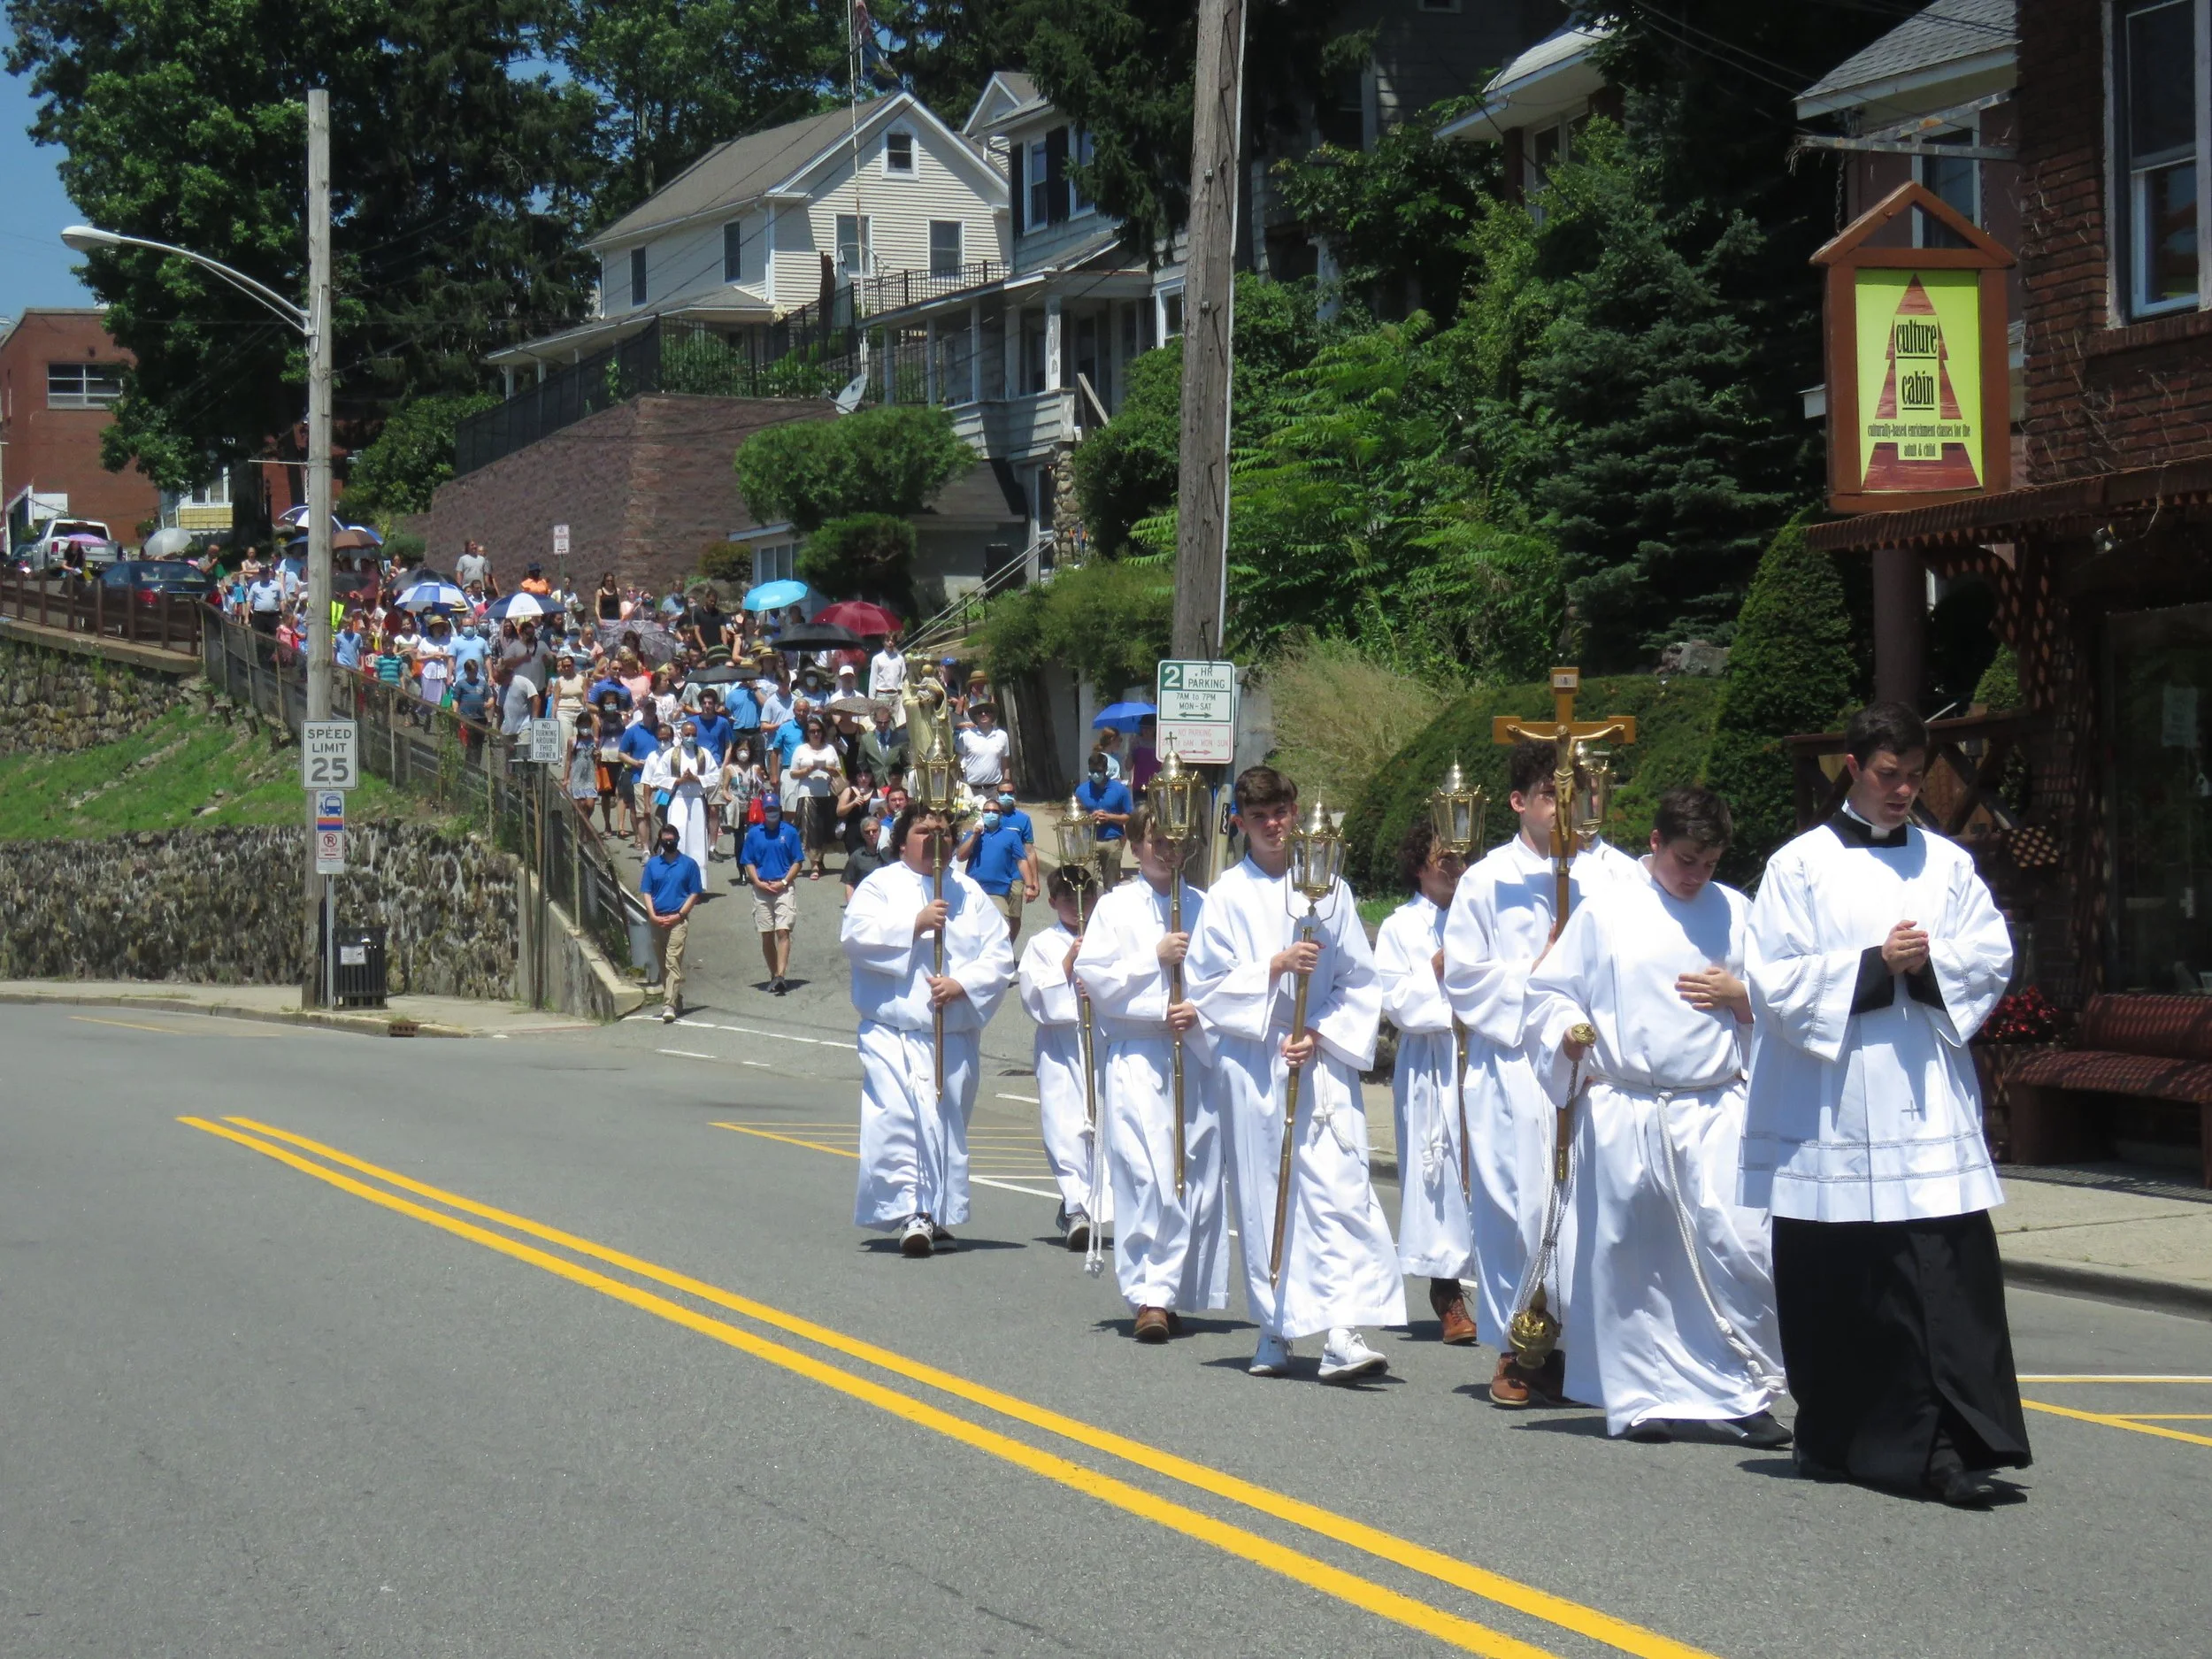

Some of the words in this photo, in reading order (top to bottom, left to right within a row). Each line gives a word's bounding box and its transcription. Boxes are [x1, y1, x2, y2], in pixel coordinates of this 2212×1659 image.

[1895, 319, 1938, 354] culture
[1901, 369, 1935, 405] cabin
[1908, 423, 1936, 437] enrichment
[1962, 423, 1971, 437] the
[1903, 442, 1917, 457] adult
[1917, 442, 1923, 457] &
[1923, 442, 1936, 457] child
[1164, 665, 1181, 687] 2
[1200, 666, 1213, 677] HR
[1187, 678, 1225, 689] PARKING
[307, 728, 352, 740] SPEED
[311, 742, 347, 753] LIMIT
[311, 757, 349, 782] 25
